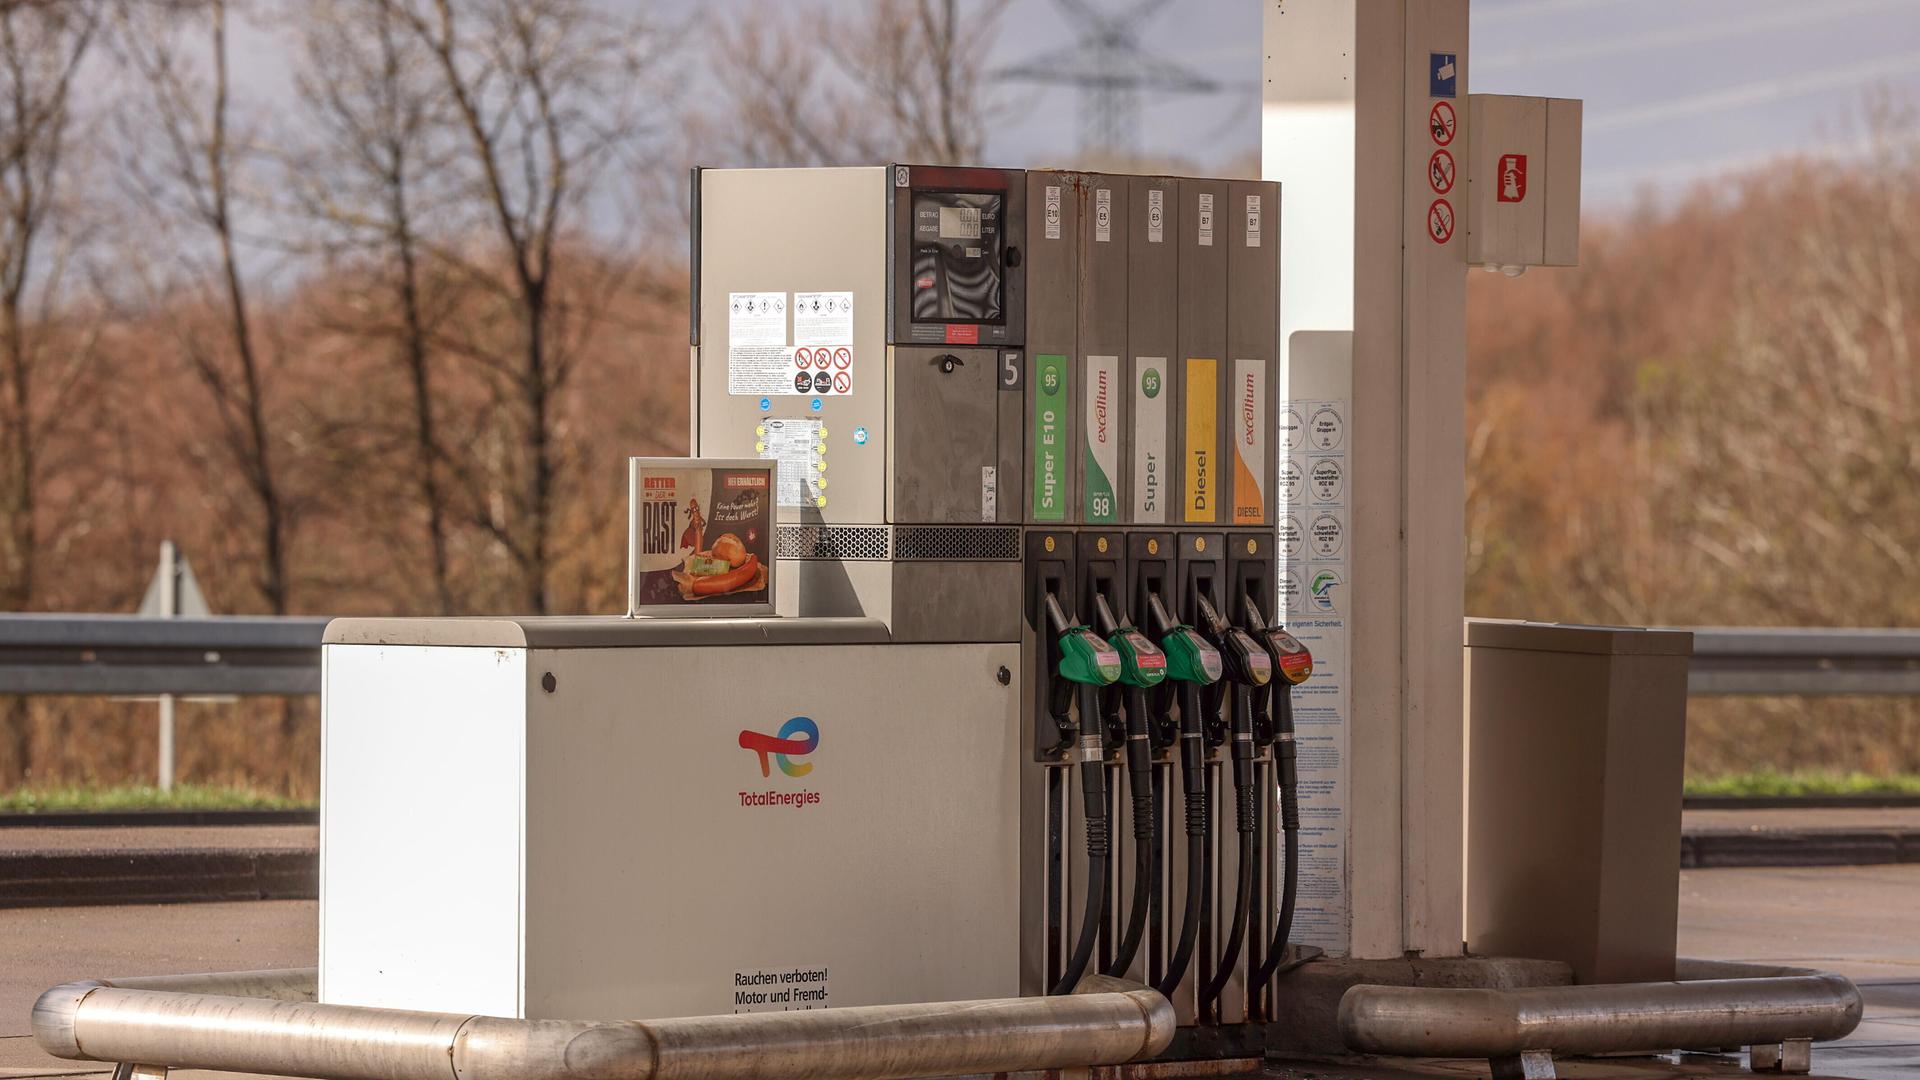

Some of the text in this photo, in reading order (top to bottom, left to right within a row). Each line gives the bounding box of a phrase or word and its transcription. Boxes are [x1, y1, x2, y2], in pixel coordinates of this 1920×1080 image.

[1047, 209, 1058, 218] E10
[1099, 212, 1107, 221] E5
[1151, 213, 1160, 221] E5
[1249, 218, 1257, 226] B7
[1004, 354, 1018, 386] 5
[1045, 374, 1057, 387] 95
[1146, 377, 1157, 390] 95
[1096, 370, 1107, 443] excellium
[1244, 373, 1255, 445] excellium
[1042, 410, 1056, 508] Super E10
[1144, 452, 1158, 512] Super
[1194, 450, 1206, 511] Diesel
[1093, 498, 1110, 517] 98
[1237, 507, 1261, 518] DIESEL
[643, 502, 677, 554] RAST
[738, 788, 820, 808] TotalEnergies
[735, 967, 828, 987] Rauchen verboten!
[735, 986, 828, 1005] Motor und Fremd-
